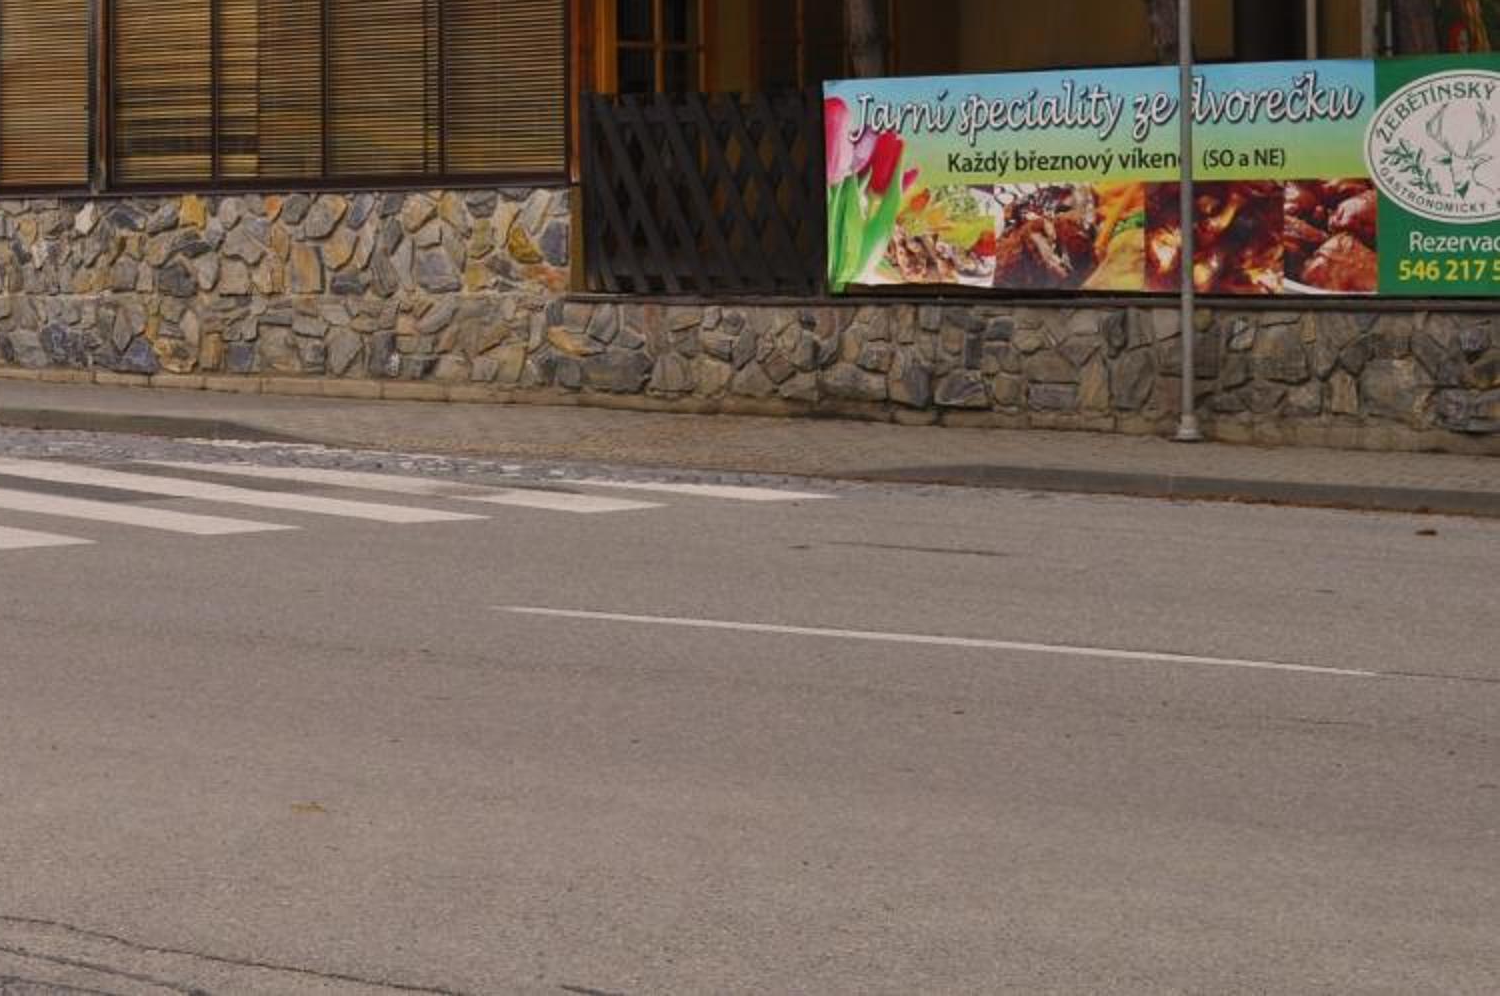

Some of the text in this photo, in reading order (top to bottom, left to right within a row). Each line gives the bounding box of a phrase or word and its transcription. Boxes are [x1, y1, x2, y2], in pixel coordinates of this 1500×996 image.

[849, 88, 956, 143] Jarní
[1132, 90, 1178, 142] ze
[947, 146, 1287, 177] Každý březnový víken (SO a NE)
[1398, 259, 1441, 281] 546
[1444, 259, 1488, 281] 217
